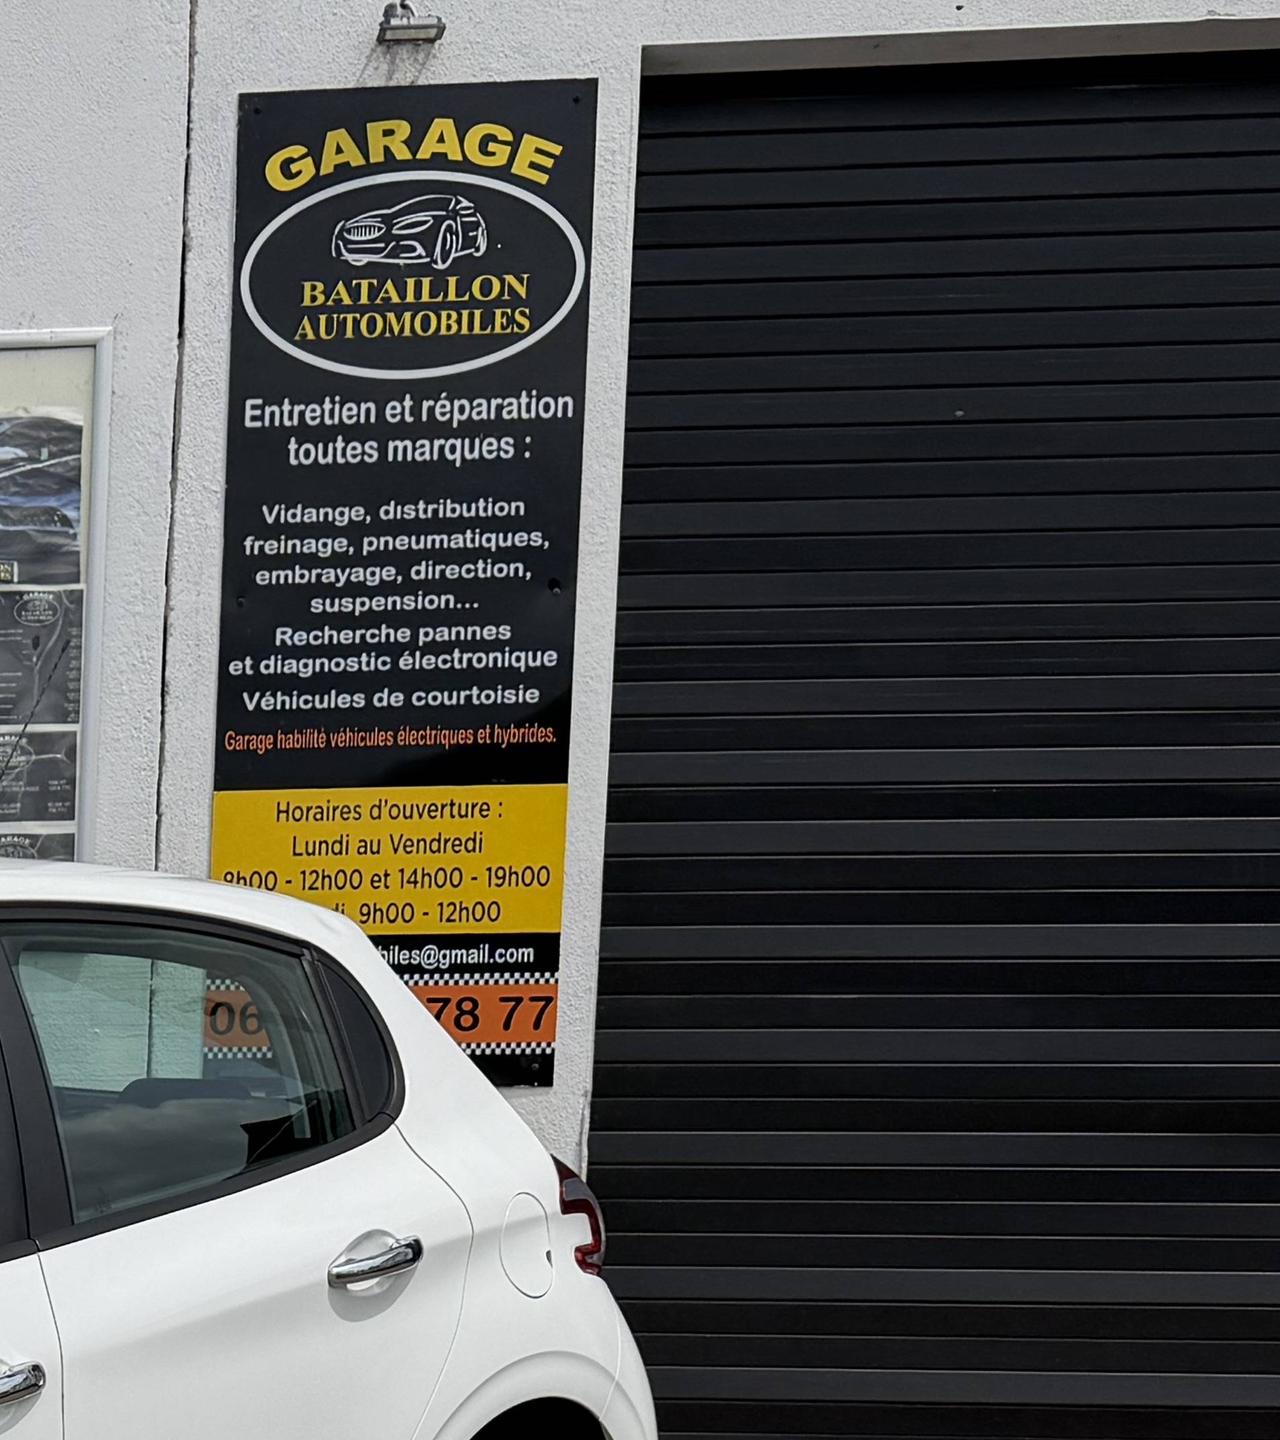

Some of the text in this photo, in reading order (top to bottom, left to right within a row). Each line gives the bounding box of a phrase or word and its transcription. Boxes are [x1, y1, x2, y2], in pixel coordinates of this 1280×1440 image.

[264, 117, 563, 193] GARAGE
[300, 273, 531, 307] BATAILLON
[294, 307, 531, 341] AUTOMOBILES
[243, 390, 574, 428] Entretien et réparation
[288, 435, 379, 466] toutes
[387, 435, 514, 467] marques
[261, 498, 526, 527] Vidange, distribution
[243, 528, 550, 558] freinage, pneumatiques,
[255, 559, 533, 588] embrayage, direction,
[310, 590, 480, 616] suspension...
[275, 623, 512, 647] Recherche pannes
[228, 647, 558, 679] et diagnostic électronique
[242, 684, 540, 712] Véhicules de courtoisie
[224, 722, 557, 755] Garage habilité véhicules électriques et hybrides.
[275, 799, 362, 823] Horaires
[368, 797, 490, 821] d'ouverture
[292, 830, 484, 857] Lundi au Vendredi
[300, 867, 363, 891] 12h00
[370, 869, 391, 890] et
[398, 866, 464, 890] 14h00
[485, 864, 551, 888] 19h00
[358, 902, 415, 924] 9h00
[437, 900, 502, 924] 12h00
[209, 996, 554, 1036] 06 78 77
